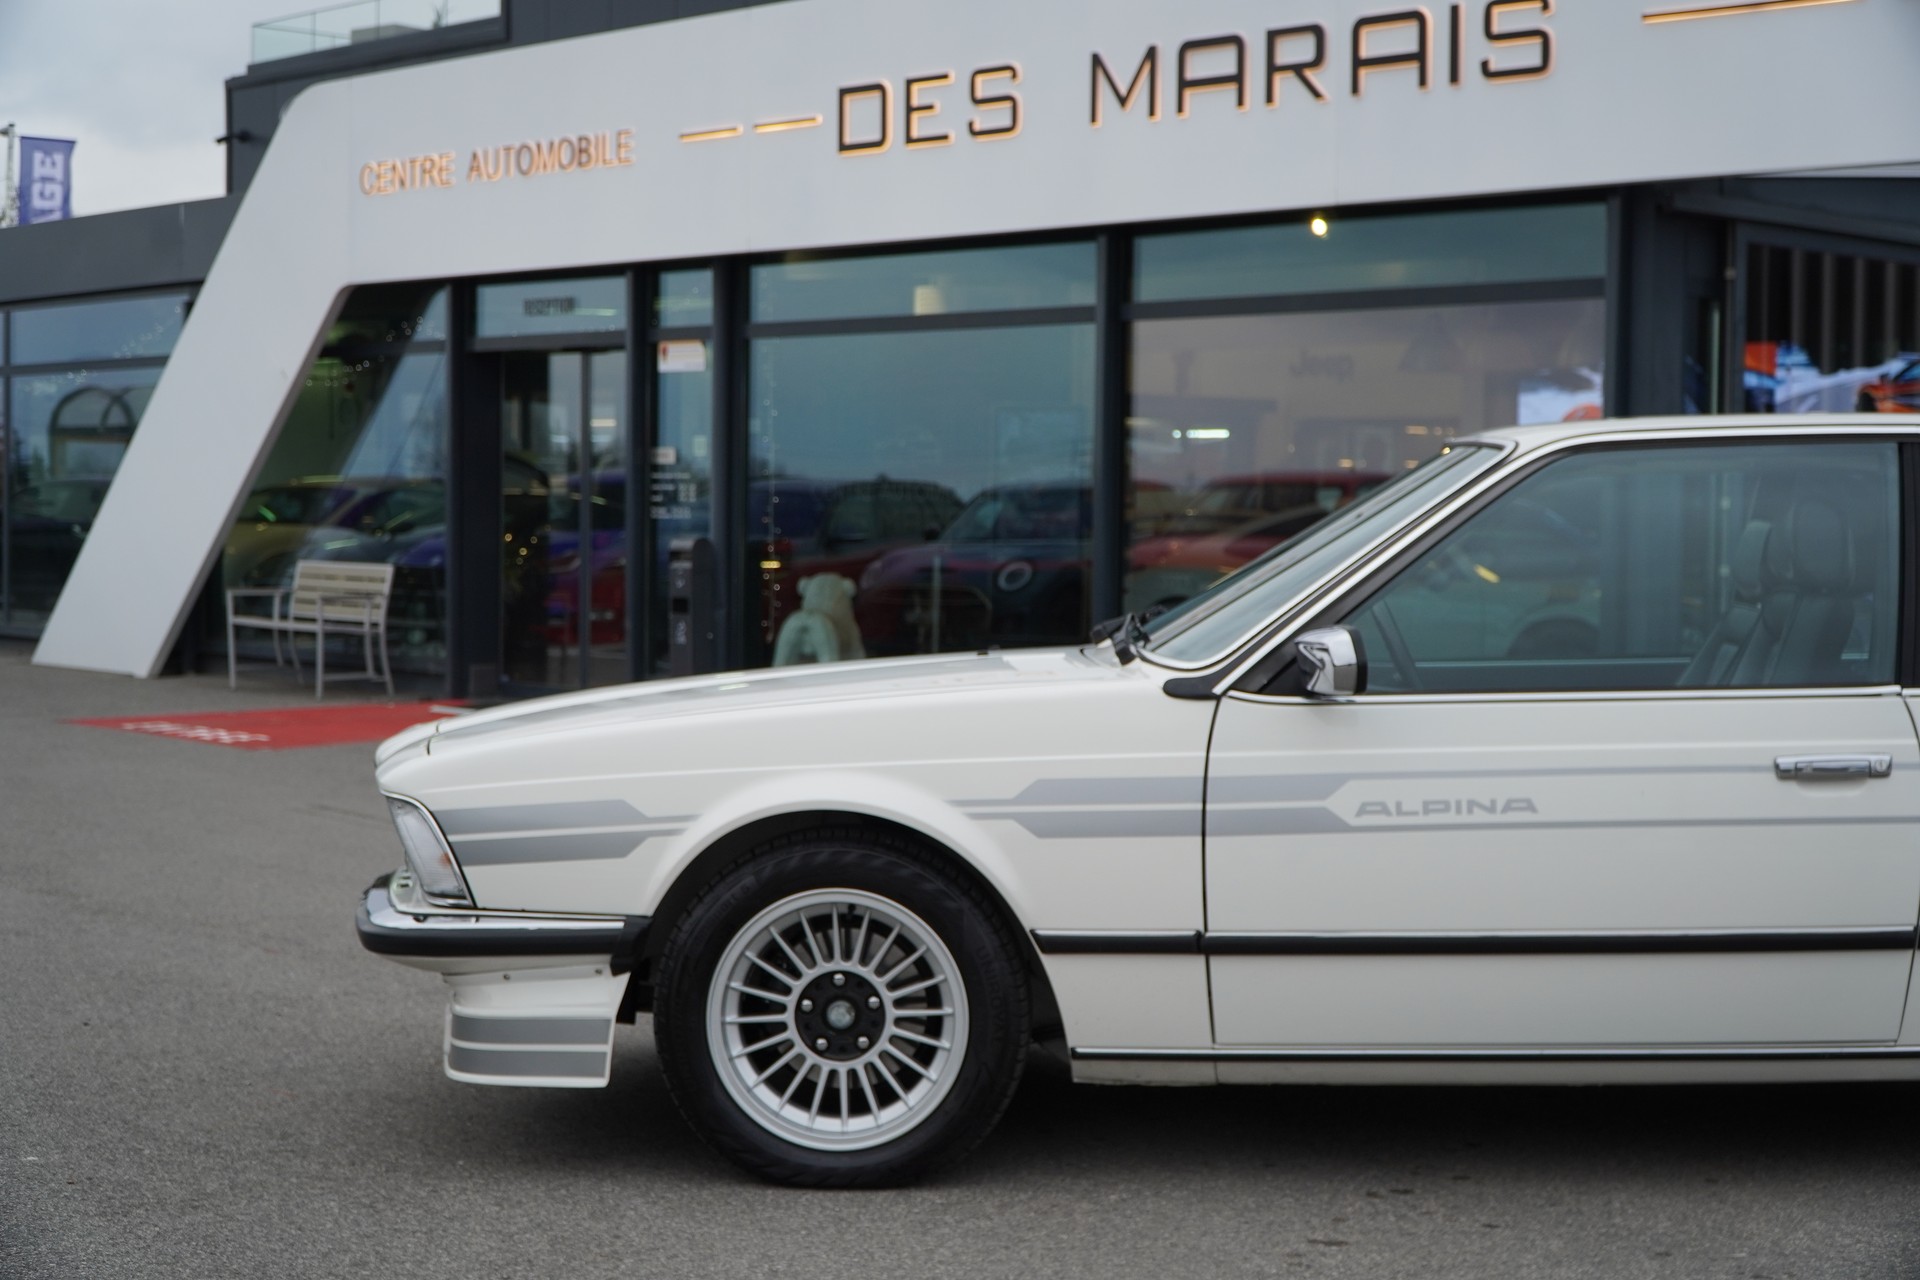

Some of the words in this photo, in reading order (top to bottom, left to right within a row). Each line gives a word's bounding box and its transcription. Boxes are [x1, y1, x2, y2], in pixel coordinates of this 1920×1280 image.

[836, 64, 1021, 156] DES
[1089, 0, 1553, 126] MARAIS
[359, 152, 455, 196] CENTRE
[467, 129, 634, 181] AUTOMOBILE
[1355, 798, 1538, 817] ALPINA
